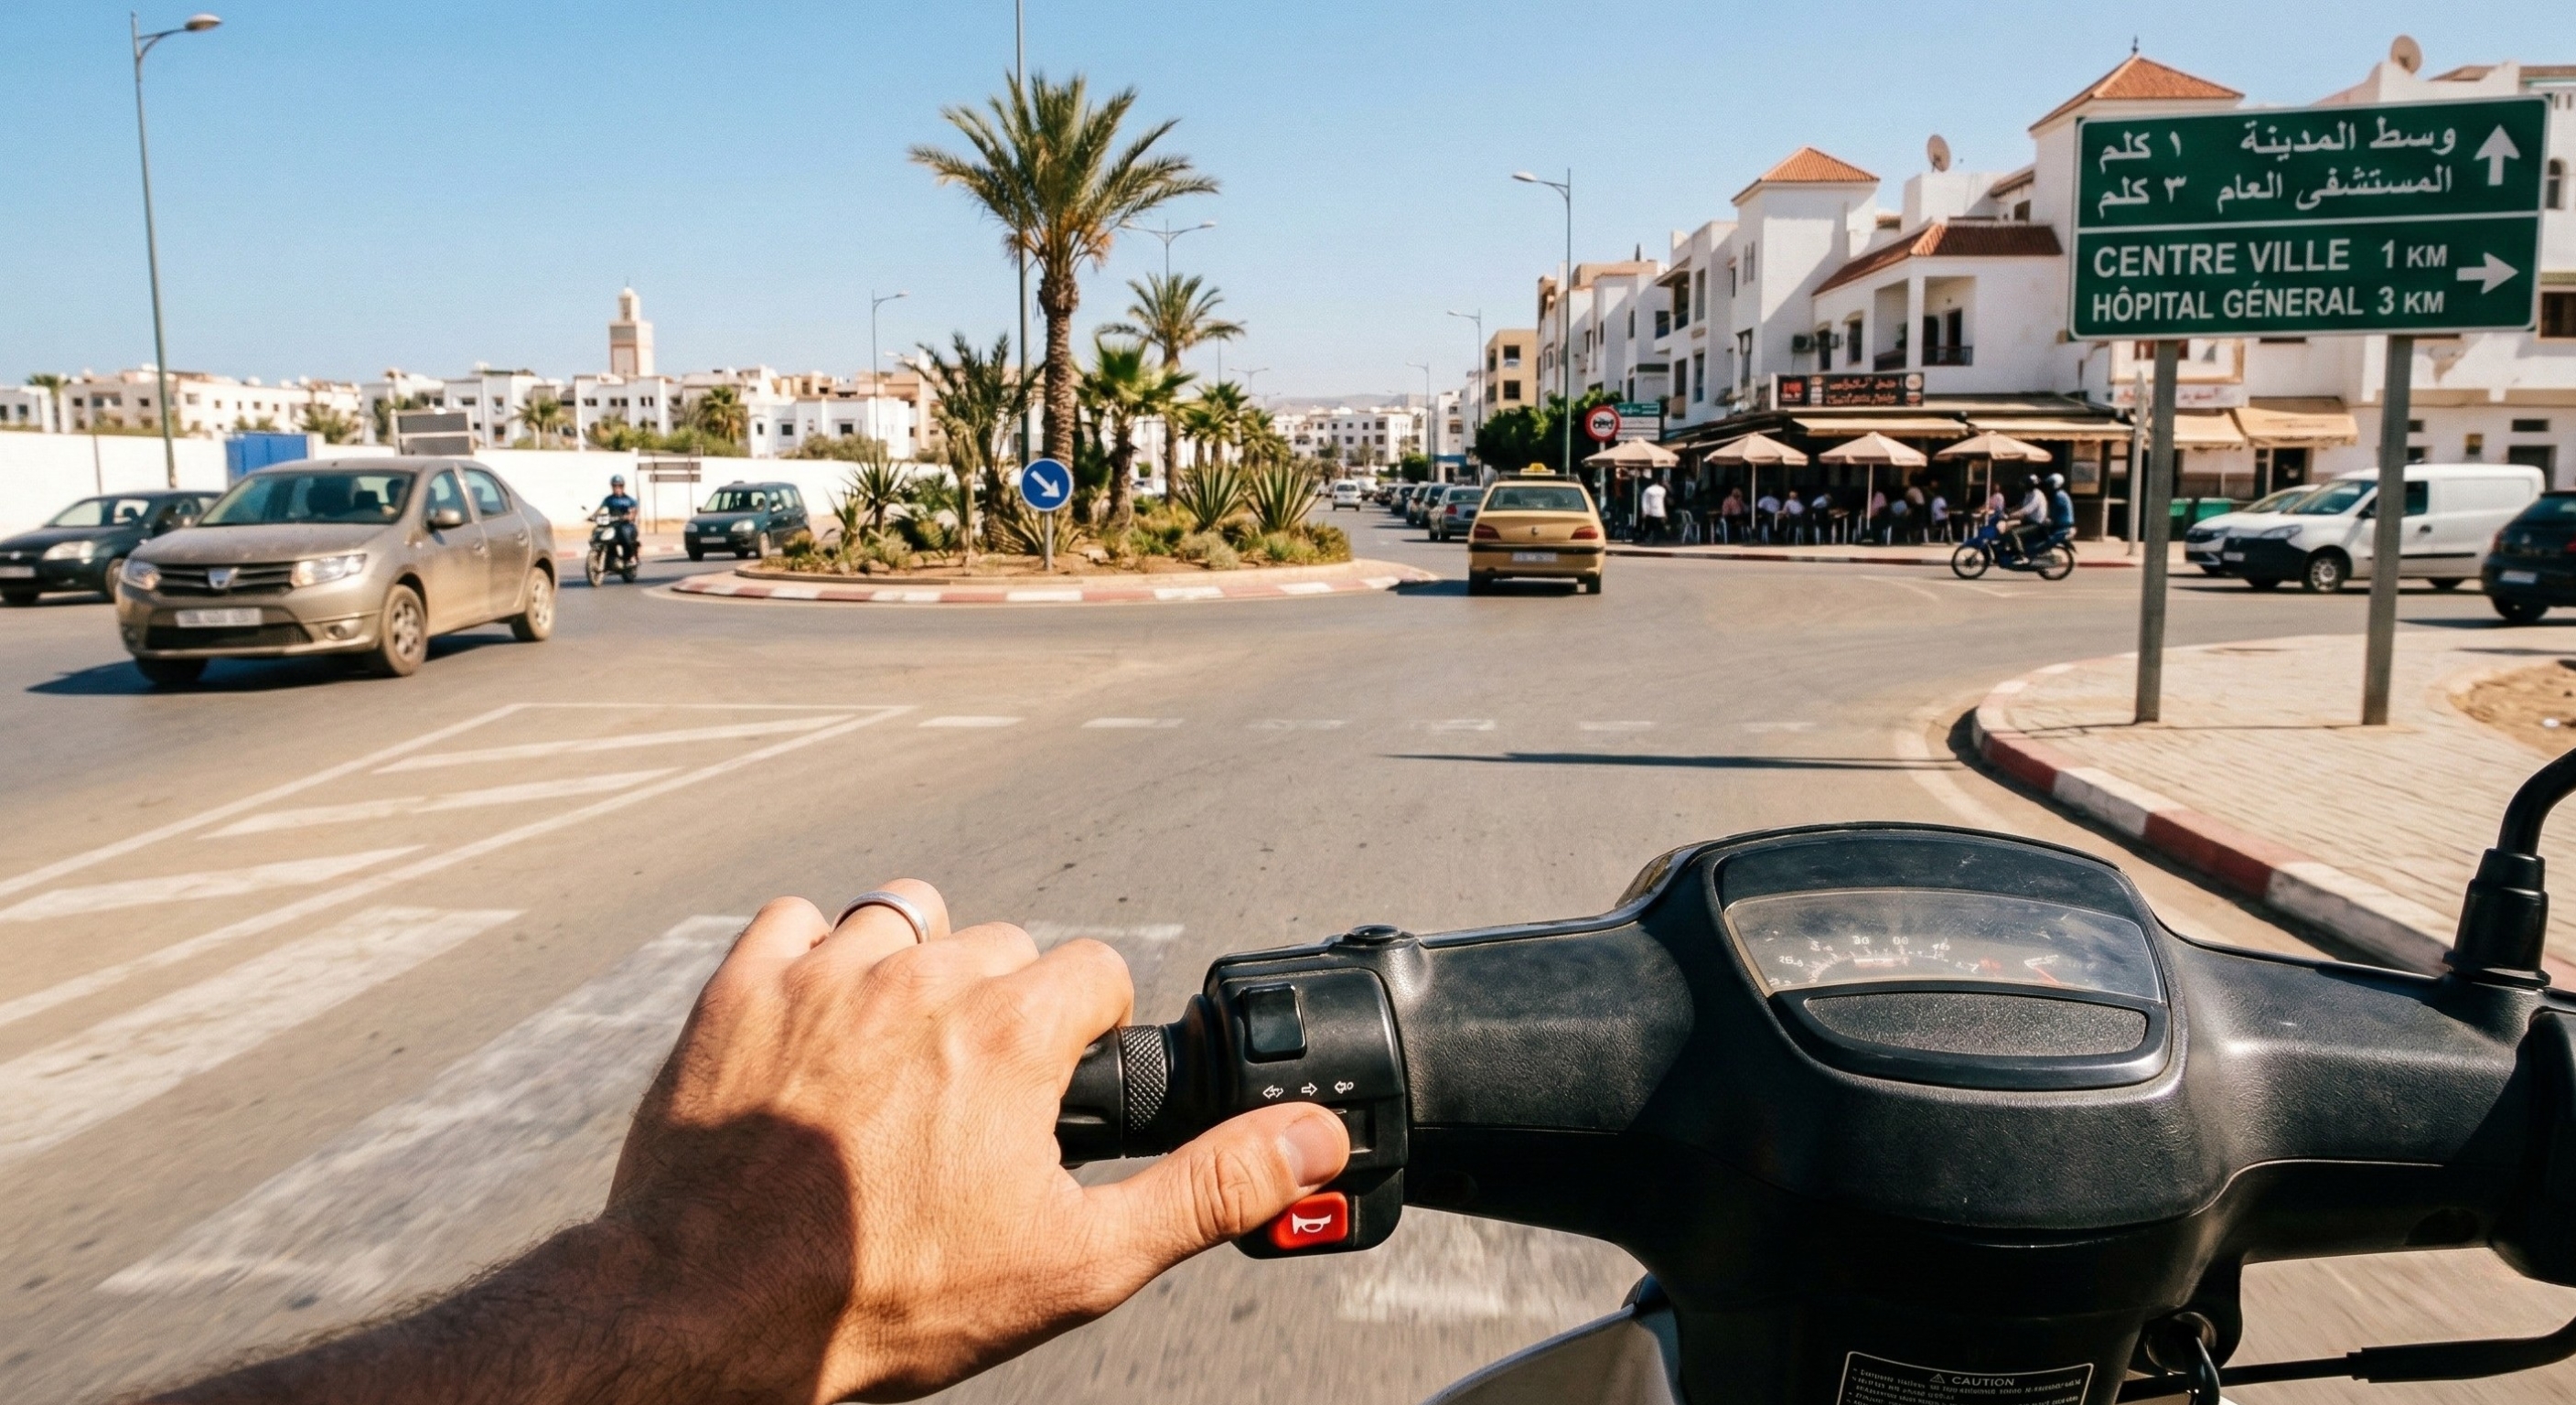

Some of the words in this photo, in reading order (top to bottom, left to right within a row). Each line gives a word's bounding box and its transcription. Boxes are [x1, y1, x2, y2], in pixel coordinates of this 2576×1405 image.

[2099, 131, 2152, 172] كلم
[2169, 131, 2181, 156] ١
[2240, 120, 2356, 162] المدينة
[2370, 117, 2455, 155] وسط
[2098, 177, 2150, 218] كلم
[2163, 176, 2187, 201] ٣
[2216, 171, 2282, 213] العام
[2295, 166, 2452, 210] المستشفى
[2094, 242, 2237, 278] CENTRE
[2249, 239, 2350, 273] VILLE
[2381, 240, 2394, 268] 1
[2407, 244, 2448, 267] KM
[2092, 285, 2214, 322] HÔPITAL
[2223, 281, 2364, 318] GÉNERAL
[2377, 286, 2395, 315] 3
[2404, 291, 2445, 314] KM
[1951, 1376, 2015, 1388] CAUTION
